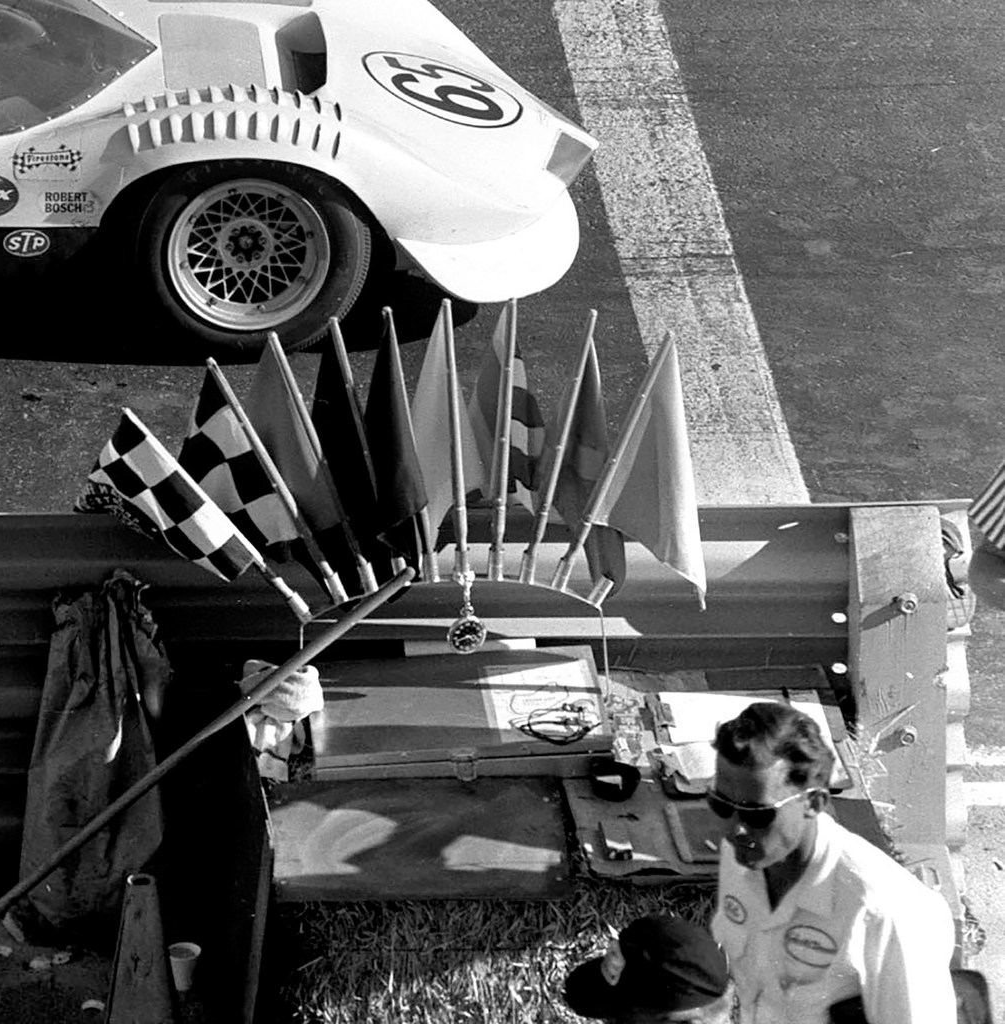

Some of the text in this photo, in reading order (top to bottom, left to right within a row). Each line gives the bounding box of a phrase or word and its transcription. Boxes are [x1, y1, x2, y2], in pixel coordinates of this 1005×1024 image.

[382, 56, 504, 121] 65
[45, 192, 88, 202] ROBERT
[45, 203, 82, 213] BOSCH
[7, 232, 46, 253] STP
